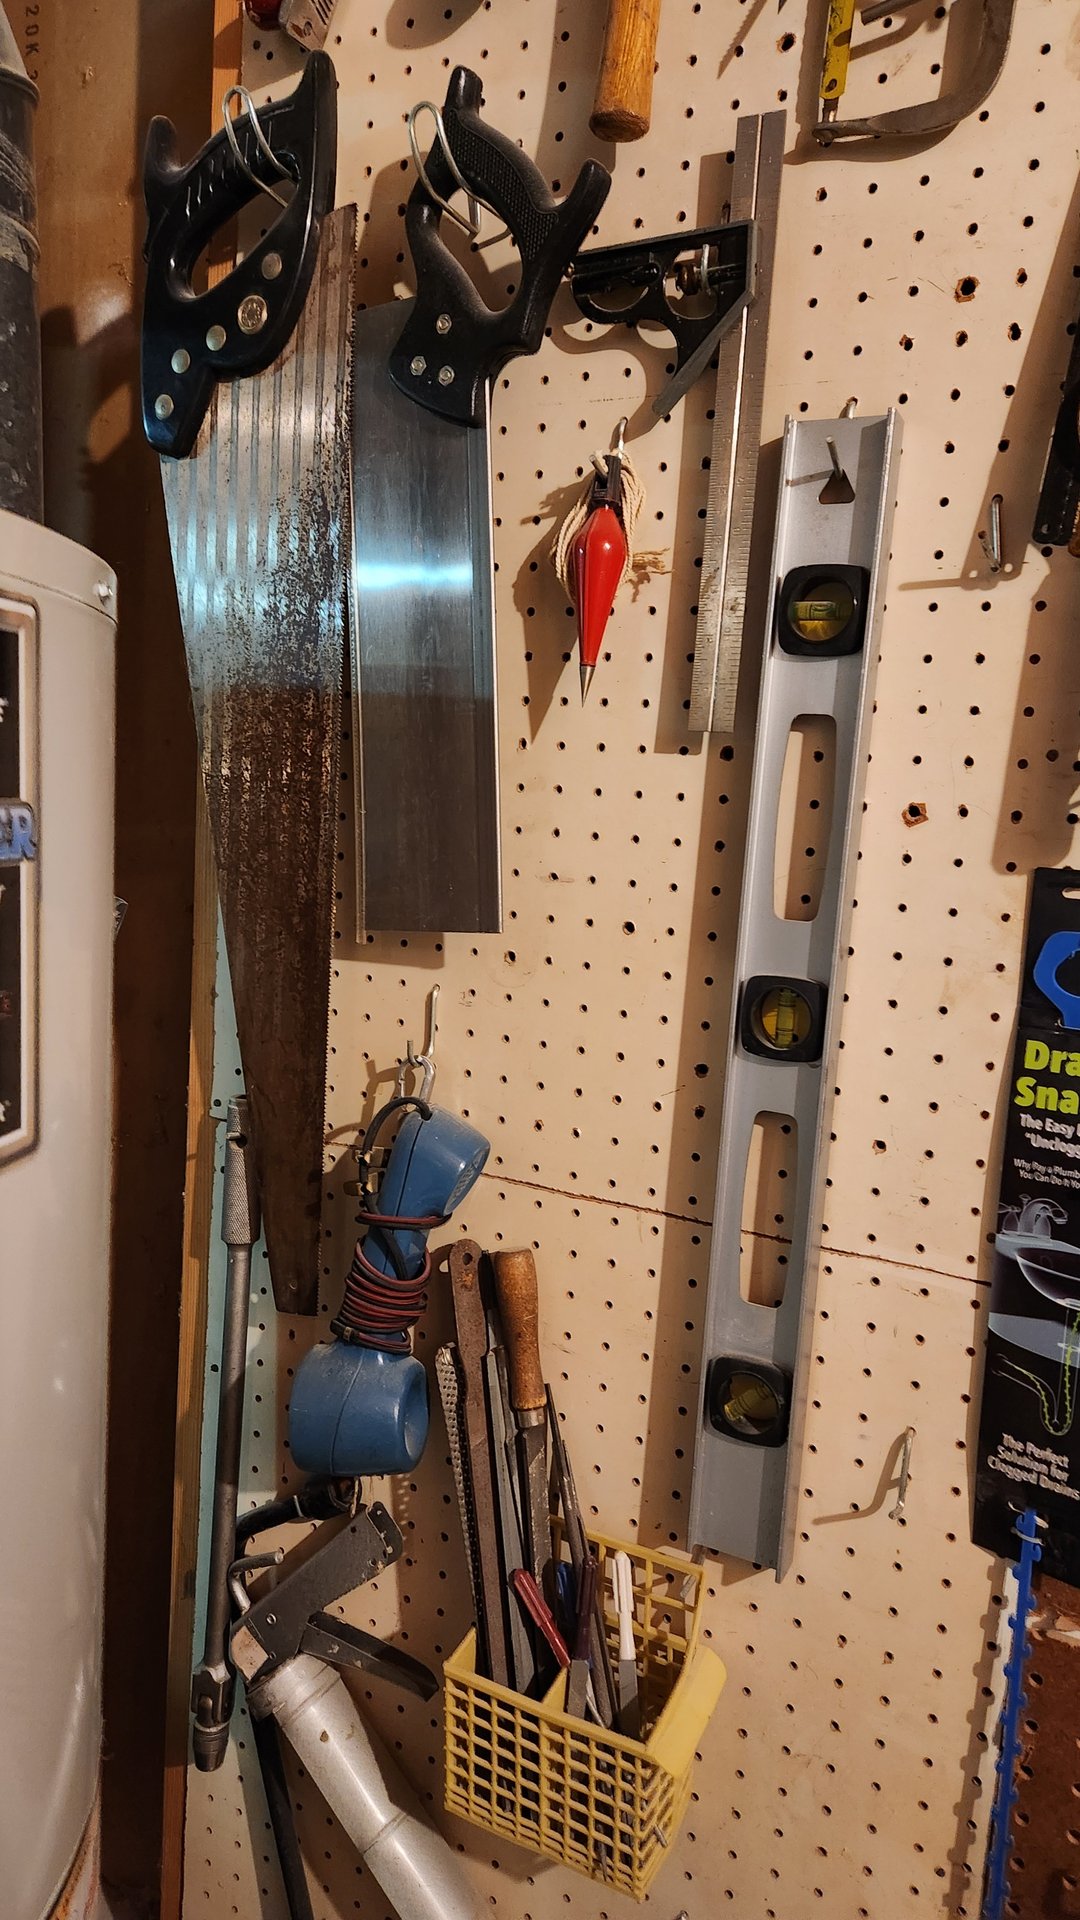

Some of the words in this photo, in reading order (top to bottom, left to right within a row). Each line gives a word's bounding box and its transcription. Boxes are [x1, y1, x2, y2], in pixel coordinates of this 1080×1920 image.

[1024, 1039, 1080, 1077] Dra
[1020, 1113, 1043, 1130] The
[1045, 1117, 1076, 1139] Easy
[1013, 1158, 1031, 1171] Why
[1031, 1161, 1046, 1174] Pay
[1019, 1169, 1034, 1180] You
[1034, 1171, 1050, 1182] Can
[997, 1445, 1049, 1475] Solution
[1002, 1432, 1025, 1452] The
[1026, 1441, 1069, 1468] Perfect
[987, 1454, 1038, 1485] Clogged
[1039, 1473, 1080, 1500] Drains
